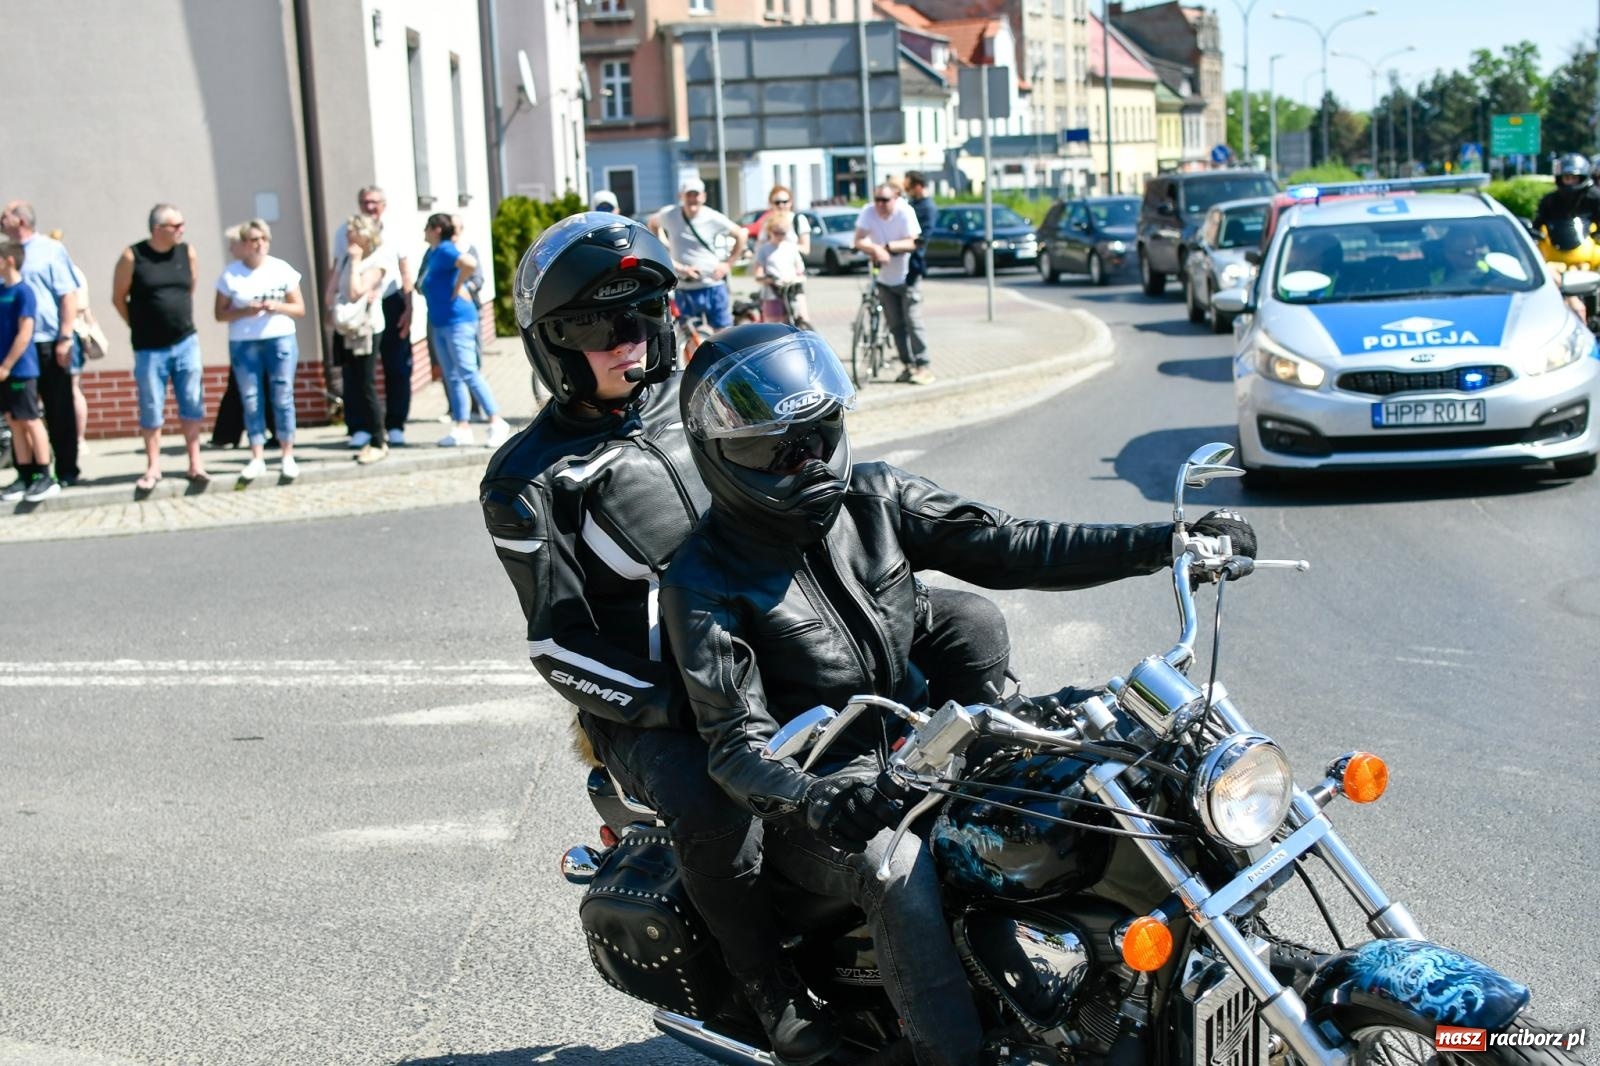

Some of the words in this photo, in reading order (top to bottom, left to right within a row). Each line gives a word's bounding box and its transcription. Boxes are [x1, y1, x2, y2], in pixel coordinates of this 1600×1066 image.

[597, 280, 635, 297] HJC
[1363, 331, 1480, 350] POLICJA
[782, 392, 821, 412] HJC
[1385, 403, 1426, 422] HPP
[1432, 402, 1482, 423] R014
[550, 669, 633, 707] SHIMA
[835, 967, 881, 978] VLX
